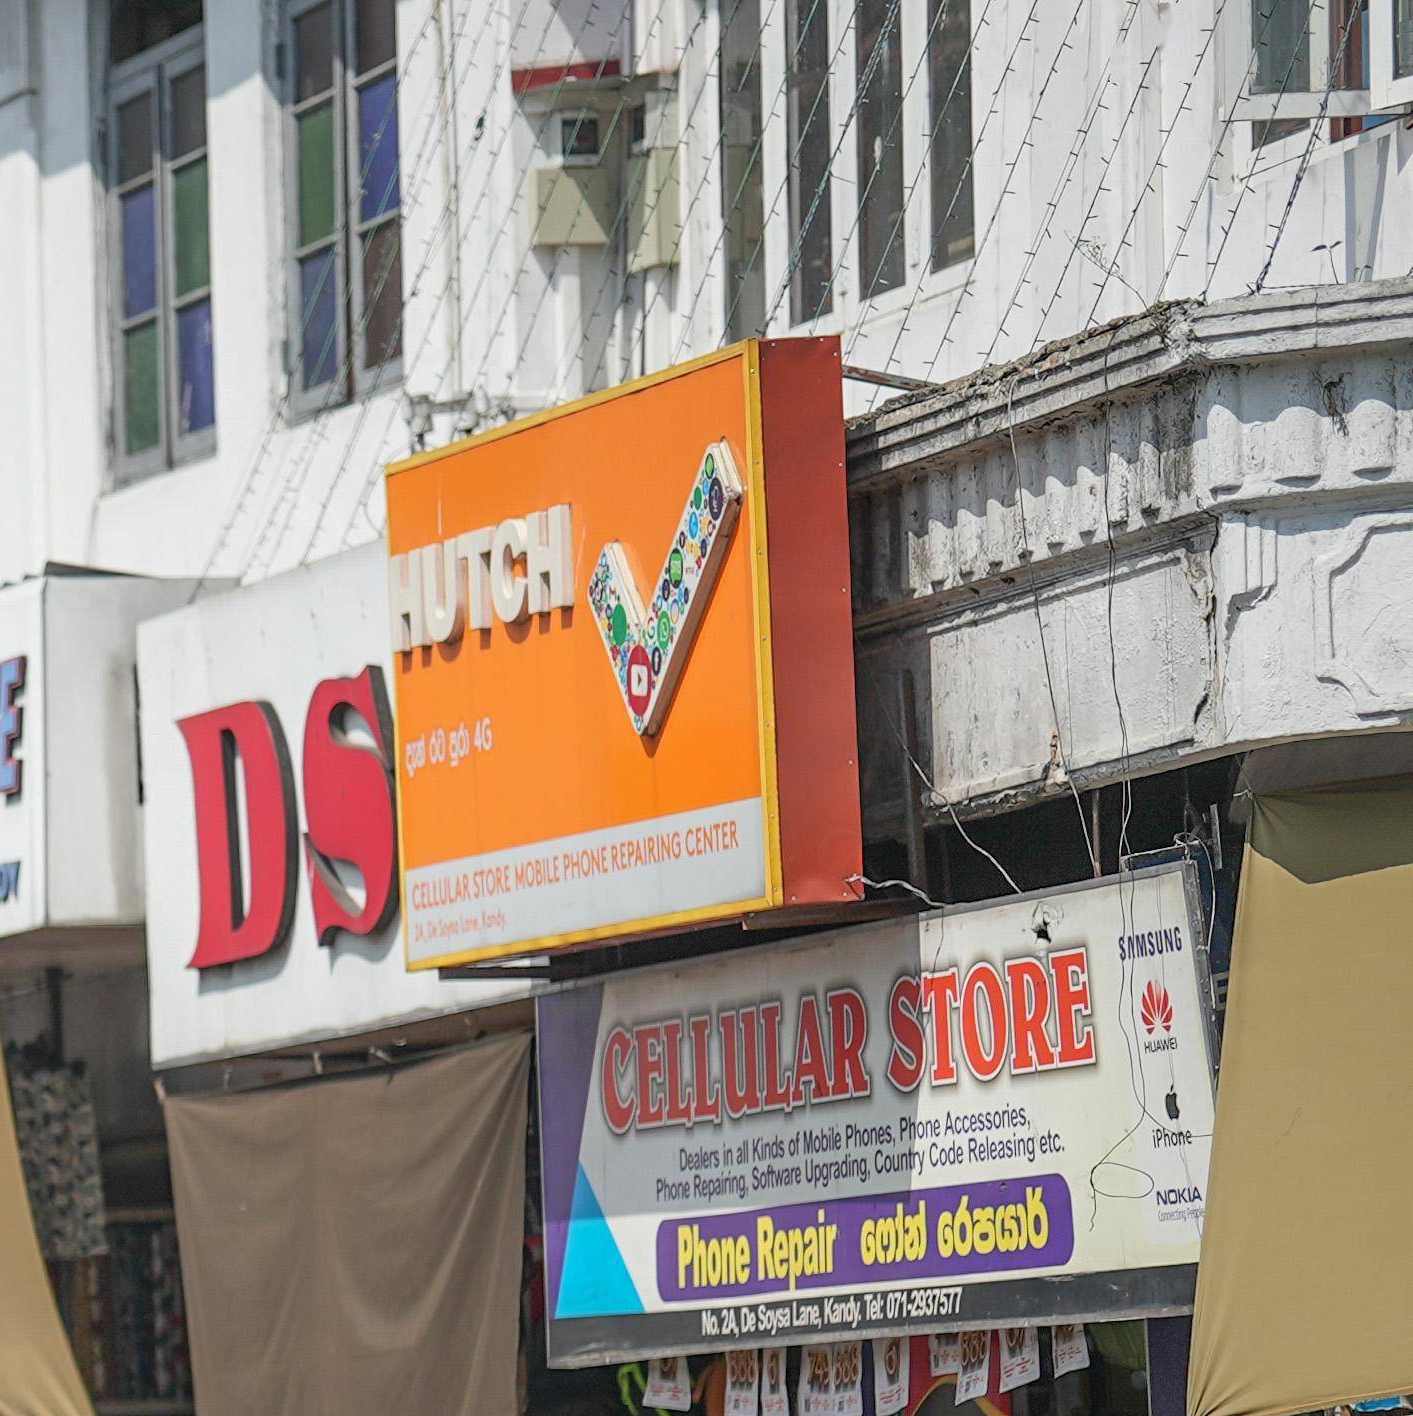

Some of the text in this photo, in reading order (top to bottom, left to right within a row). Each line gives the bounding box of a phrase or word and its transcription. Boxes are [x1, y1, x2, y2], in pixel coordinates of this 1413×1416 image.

[390, 502, 573, 655] HUTCH
[474, 717, 493, 752] 4G
[412, 820, 739, 911] CELLULAR STORE MOBILE PHONE REPAIRING CENTER
[1118, 926, 1182, 961] SAMSUNG
[602, 946, 1096, 1135] CELLULAR STORE
[1144, 1036, 1178, 1054] HUAWEI
[656, 1130, 1066, 1204] Phone Repairing, Software Upgrading, Country Code Releasing etc.
[679, 1106, 1032, 1172] Dealers in all Kinds of Mobile Phones, Phone Accessories,
[1152, 1127, 1192, 1149] iPhone
[1157, 1186, 1203, 1206] NOKIA
[677, 1208, 838, 1293] Phone Repair
[701, 1286, 963, 1338] No. 2A, De Soysa Lane, Kandy. Tel: 071-2937577
